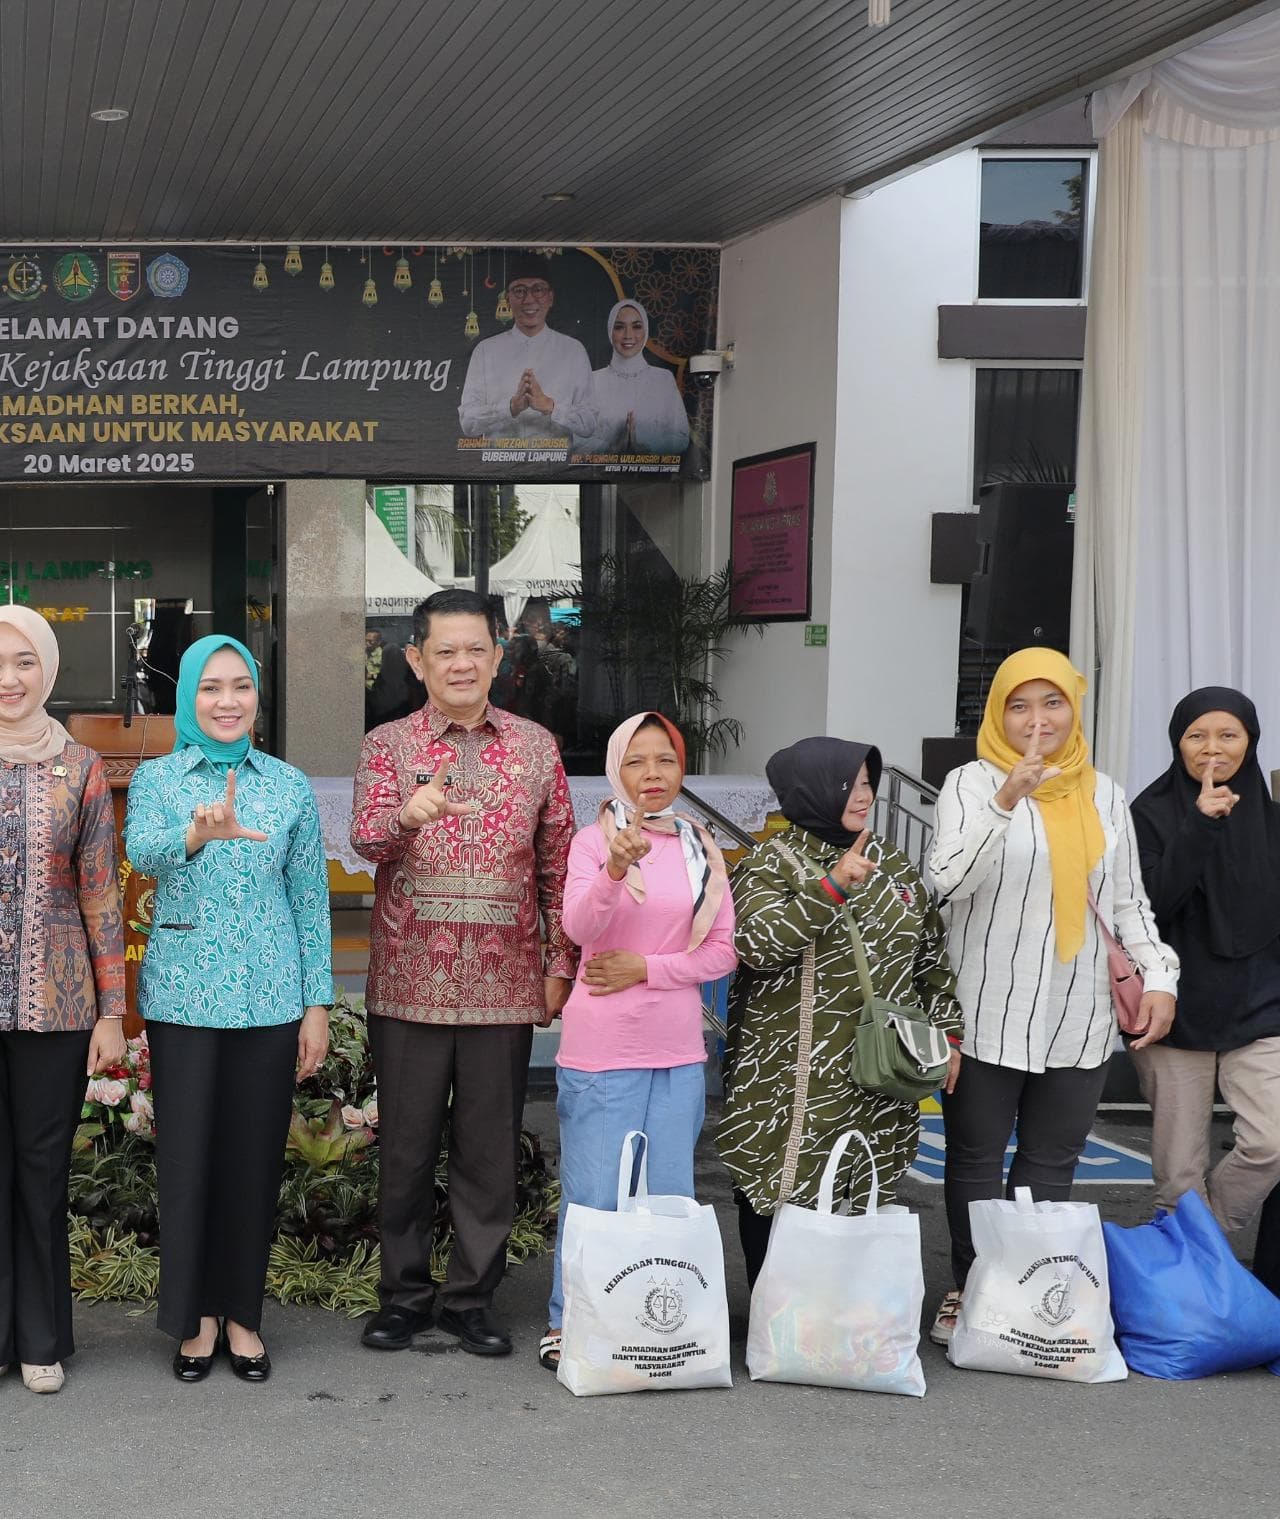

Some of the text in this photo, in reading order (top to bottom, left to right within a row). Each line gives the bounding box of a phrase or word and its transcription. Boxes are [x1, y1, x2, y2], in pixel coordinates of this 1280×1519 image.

[117, 316, 240, 339] DATANG
[179, 347, 287, 392] Tinggi
[295, 350, 452, 392] Lampung
[131, 393, 246, 418] BERKAH,
[93, 420, 185, 444] UNTUK
[191, 420, 379, 443] MASYARAKAT
[457, 437, 492, 449] RAHMAT
[481, 450, 568, 462] GUBERNUR LAMPUNG
[23, 453, 196, 474] 20 Maret 2025
[654, 1257, 688, 1269] TINGGI
[611, 1353, 638, 1361] BAKTI
[681, 1348, 707, 1359] UNTUK
[621, 1345, 669, 1354] RAMADHAN
[1019, 1349, 1077, 1363] MASYARAKAT
[634, 1360, 687, 1370] MASYARAKAT
